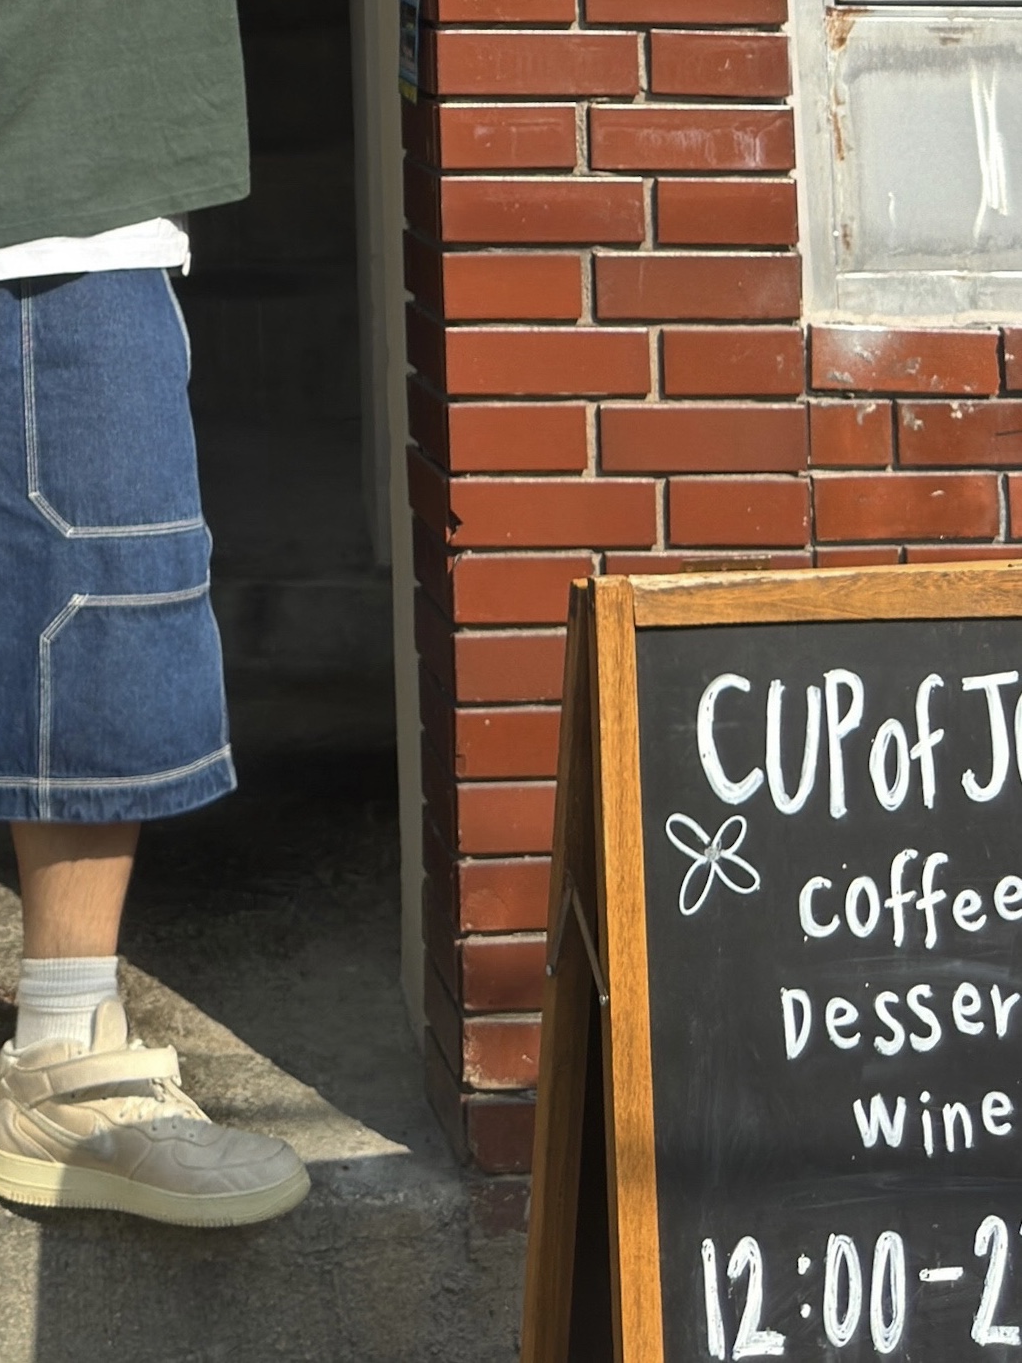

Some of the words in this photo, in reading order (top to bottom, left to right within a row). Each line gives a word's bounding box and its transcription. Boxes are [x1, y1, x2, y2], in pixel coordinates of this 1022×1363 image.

[696, 667, 865, 820] CUP
[868, 672, 945, 812] of
[961, 669, 1022, 803] J
[700, 1213, 1022, 1362] 12:00-2
